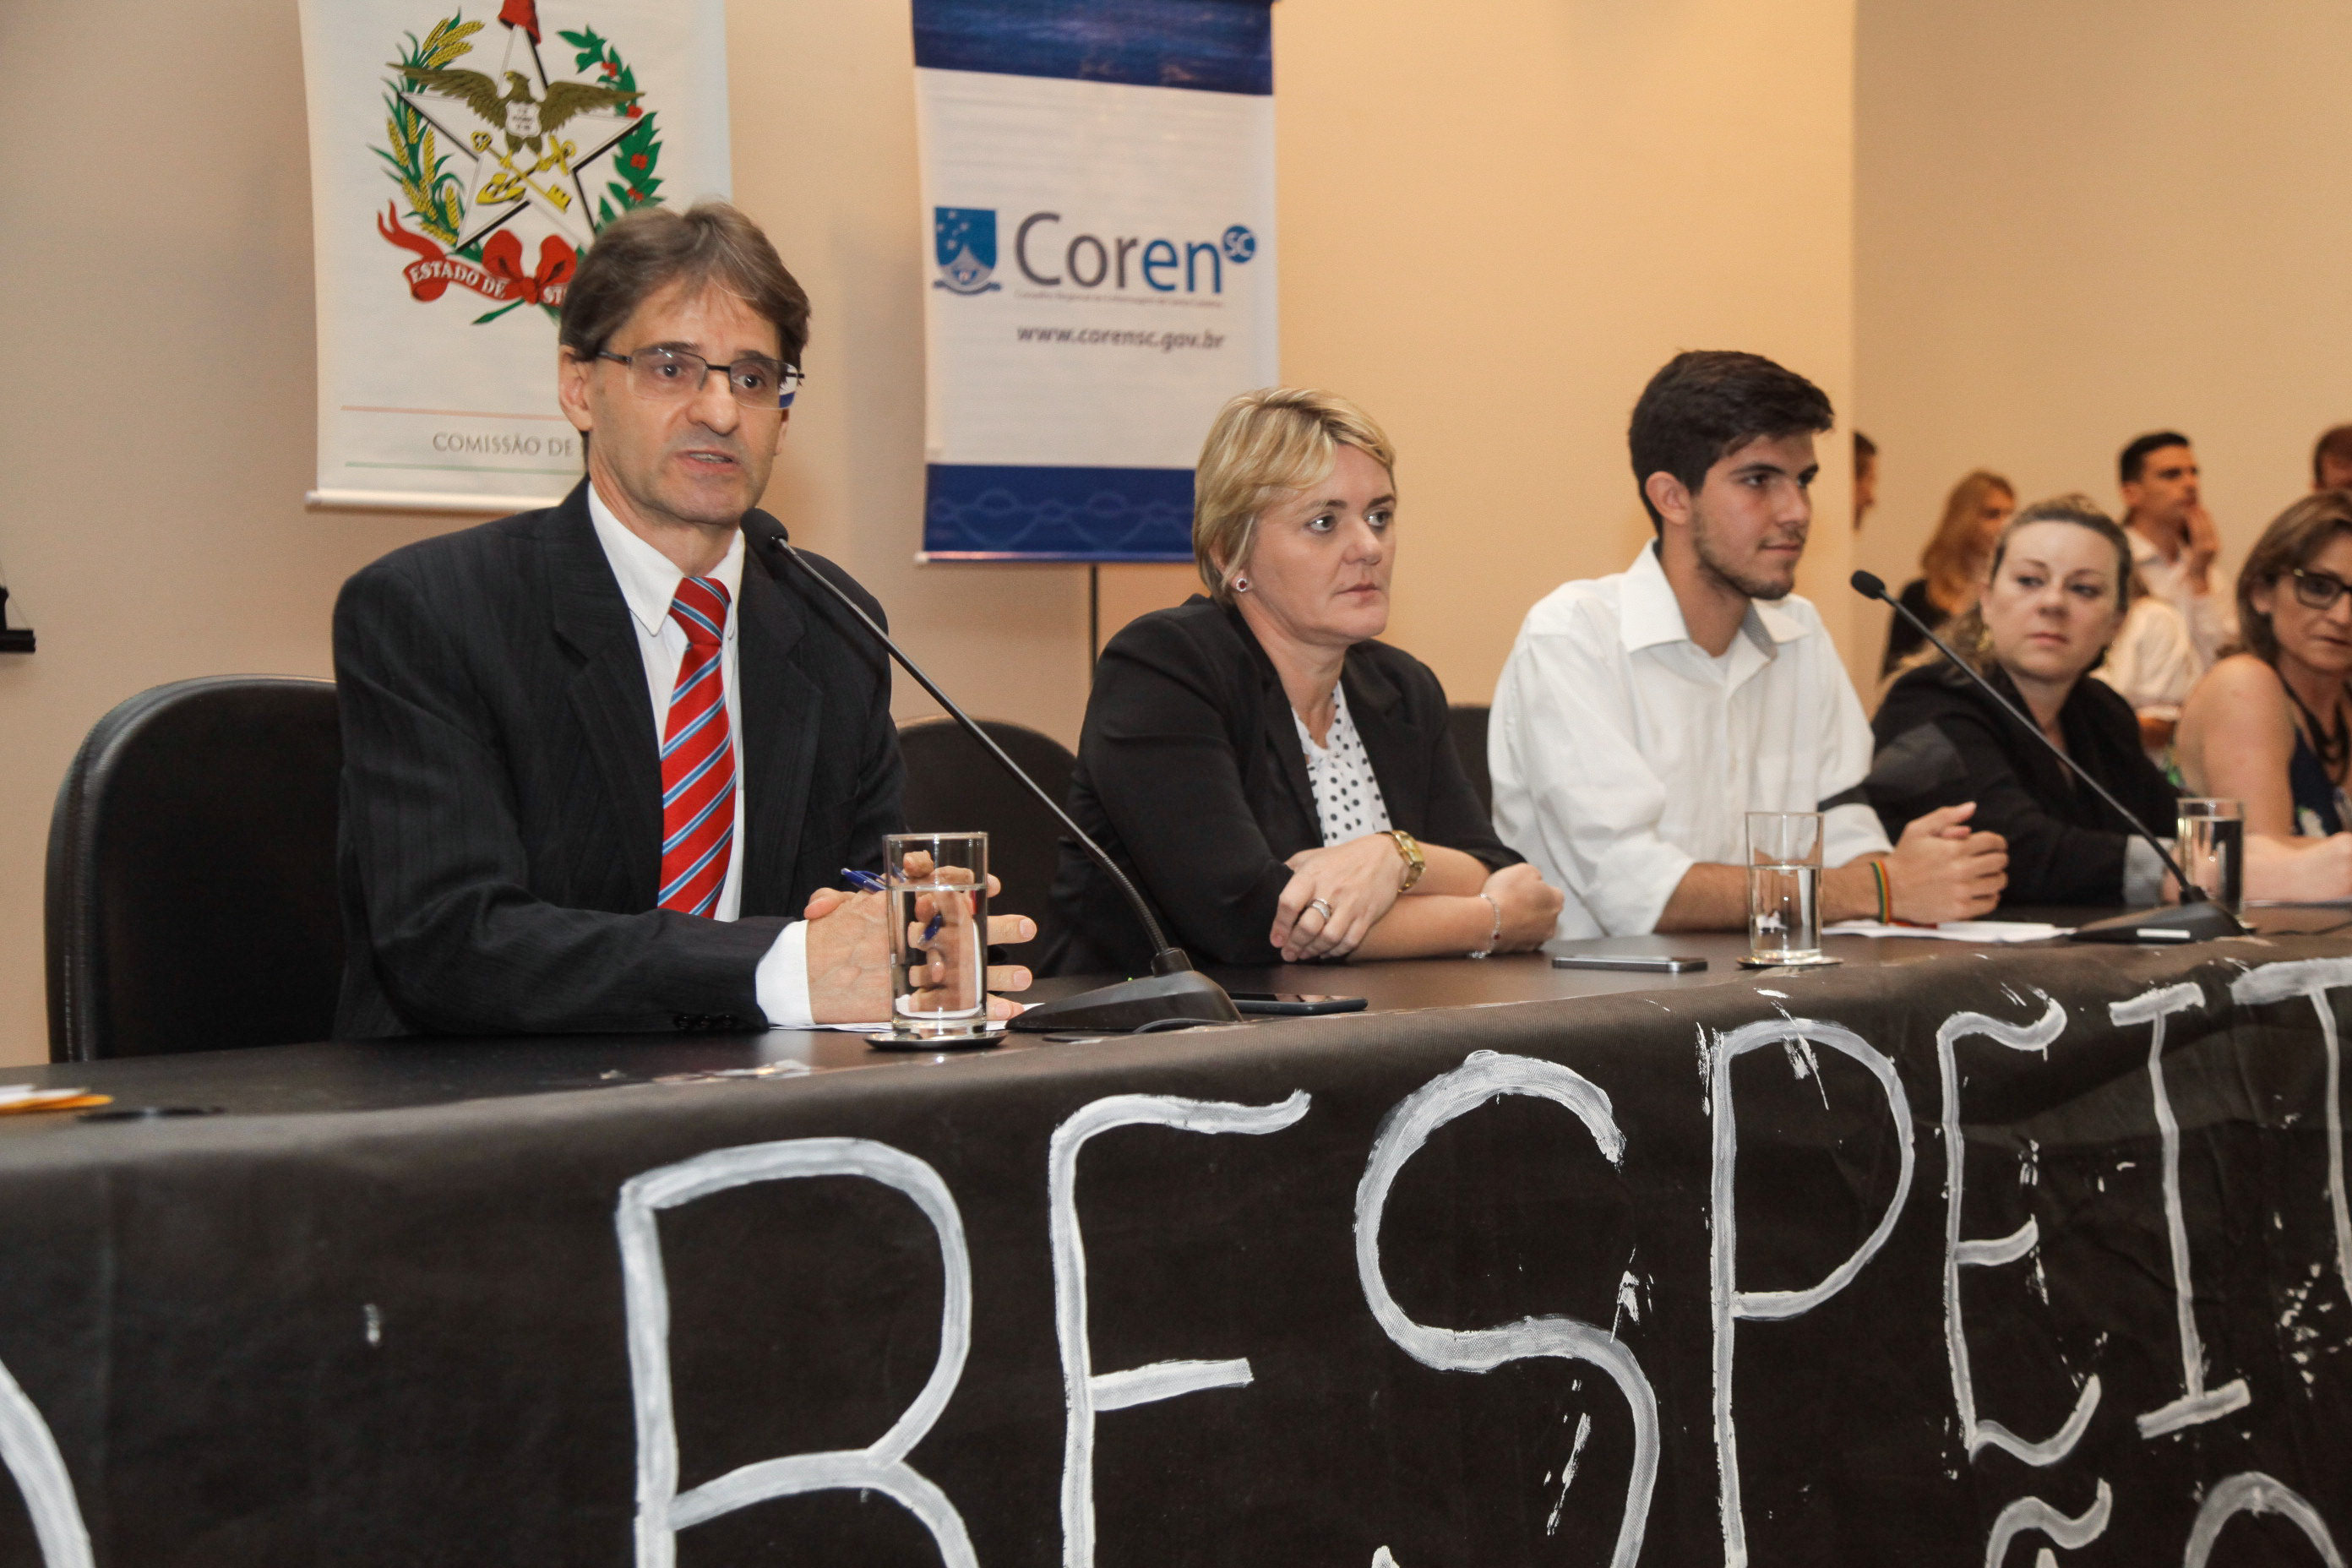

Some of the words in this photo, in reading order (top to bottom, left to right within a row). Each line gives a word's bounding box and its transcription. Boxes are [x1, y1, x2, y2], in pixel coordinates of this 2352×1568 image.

[1015, 211, 1222, 294] Coren
[1224, 230, 1254, 259] SC
[409, 260, 479, 286] ESTADO
[481, 273, 509, 298] DE
[542, 285, 568, 304] ST
[1017, 327, 1225, 353] www.corensc.gov.br
[433, 431, 542, 456] COMISSÃO
[547, 437, 574, 457] DE
